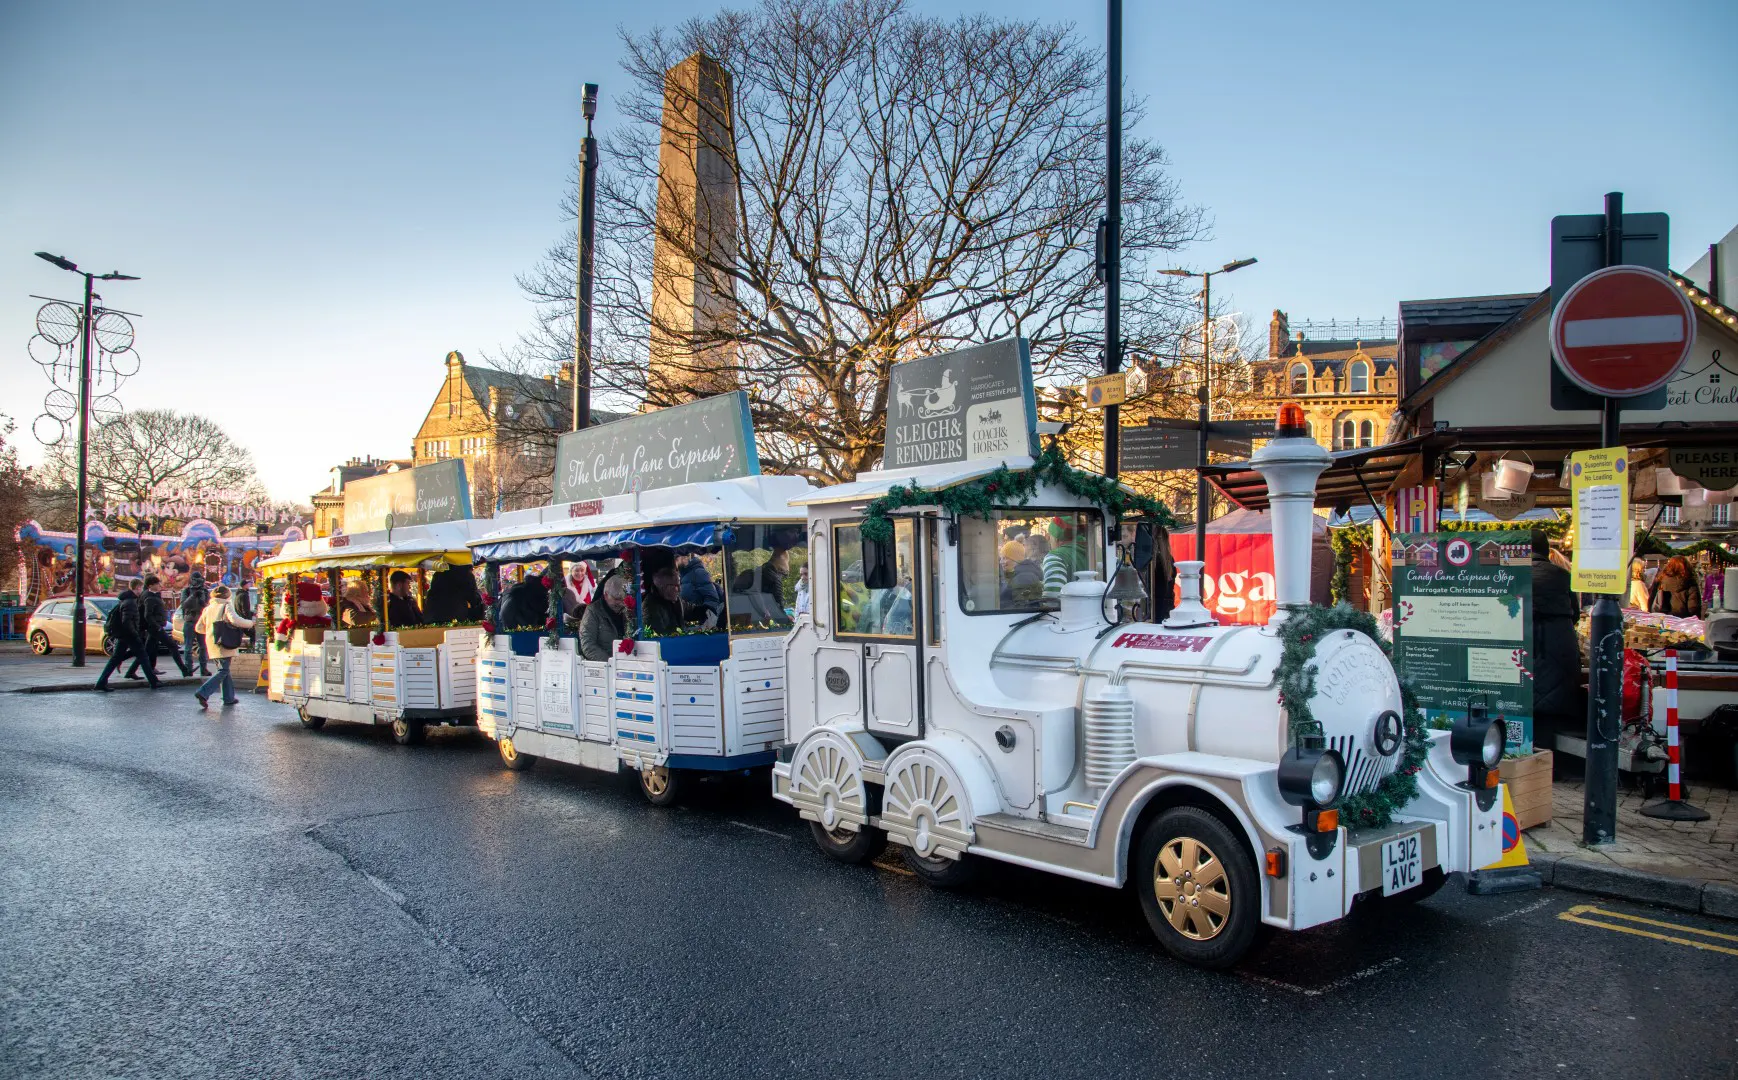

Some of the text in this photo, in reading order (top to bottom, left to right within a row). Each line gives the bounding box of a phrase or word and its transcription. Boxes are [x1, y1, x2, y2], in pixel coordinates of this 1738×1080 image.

[970, 386, 1017, 400] MOST FESTIVE PUB
[1668, 390, 1692, 406] eet
[896, 438, 962, 465] REINDEERS
[973, 439, 1009, 455] HORSES
[1584, 461, 1613, 469] Suspension
[1588, 453, 1608, 461] Parking
[1675, 452, 1730, 464] PLEASE
[568, 437, 722, 495] The Candy Cane Express
[1699, 467, 1738, 478] HERE
[1592, 473, 1613, 482] Loading
[117, 500, 277, 522] RUNAWAY TRAIN
[416, 489, 448, 522] Express
[1407, 569, 1515, 587] Candy Cane Express Stop
[1587, 581, 1607, 589] Council
[1174, 569, 1278, 615] oga
[1413, 586, 1508, 595] Harrogate Christmas Fayre
[1389, 837, 1417, 866] L312
[1391, 861, 1416, 890] AVC
